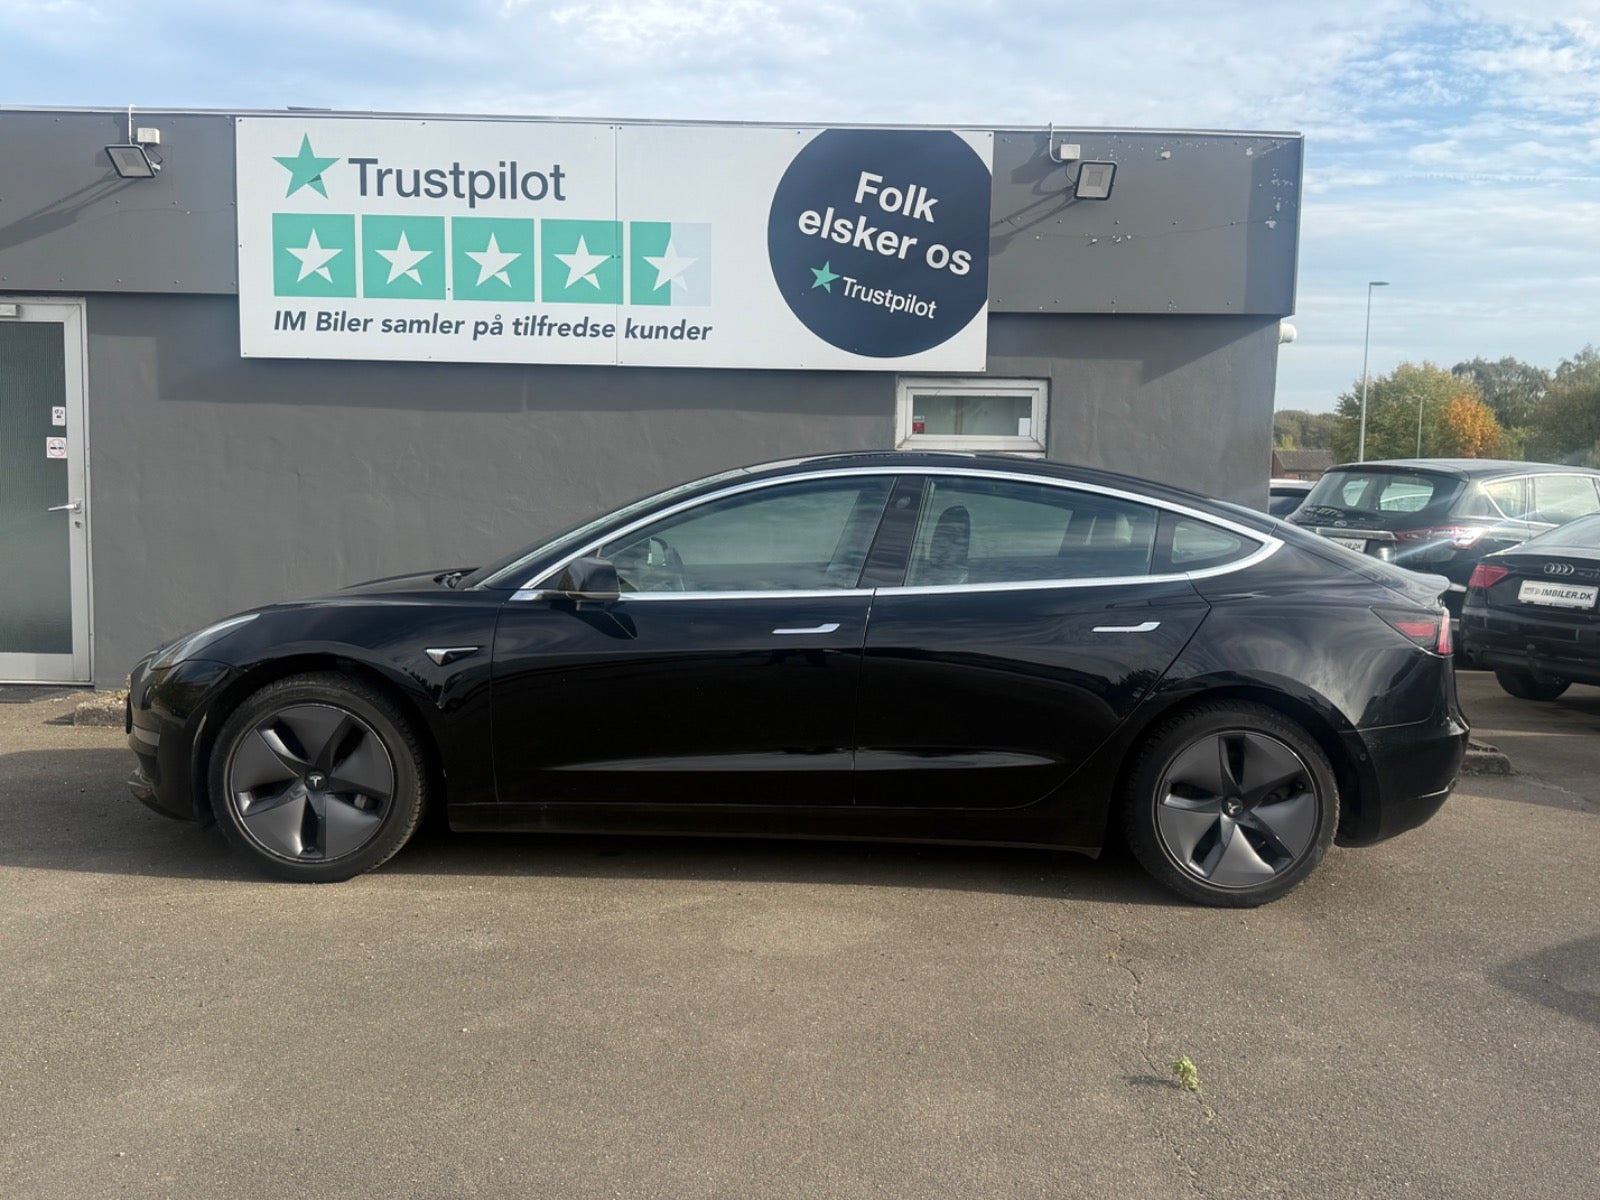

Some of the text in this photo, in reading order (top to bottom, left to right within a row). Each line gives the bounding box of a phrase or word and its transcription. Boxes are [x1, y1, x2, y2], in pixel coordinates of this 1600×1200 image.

[348, 157, 566, 208] Trustpilot
[854, 171, 939, 223] Folk
[798, 206, 972, 275] elsker os
[842, 276, 937, 319] Trustpilot
[274, 310, 714, 341] IM Biler samler på tilfredse kunder
[1540, 588, 1594, 600] IMBILER.DK
